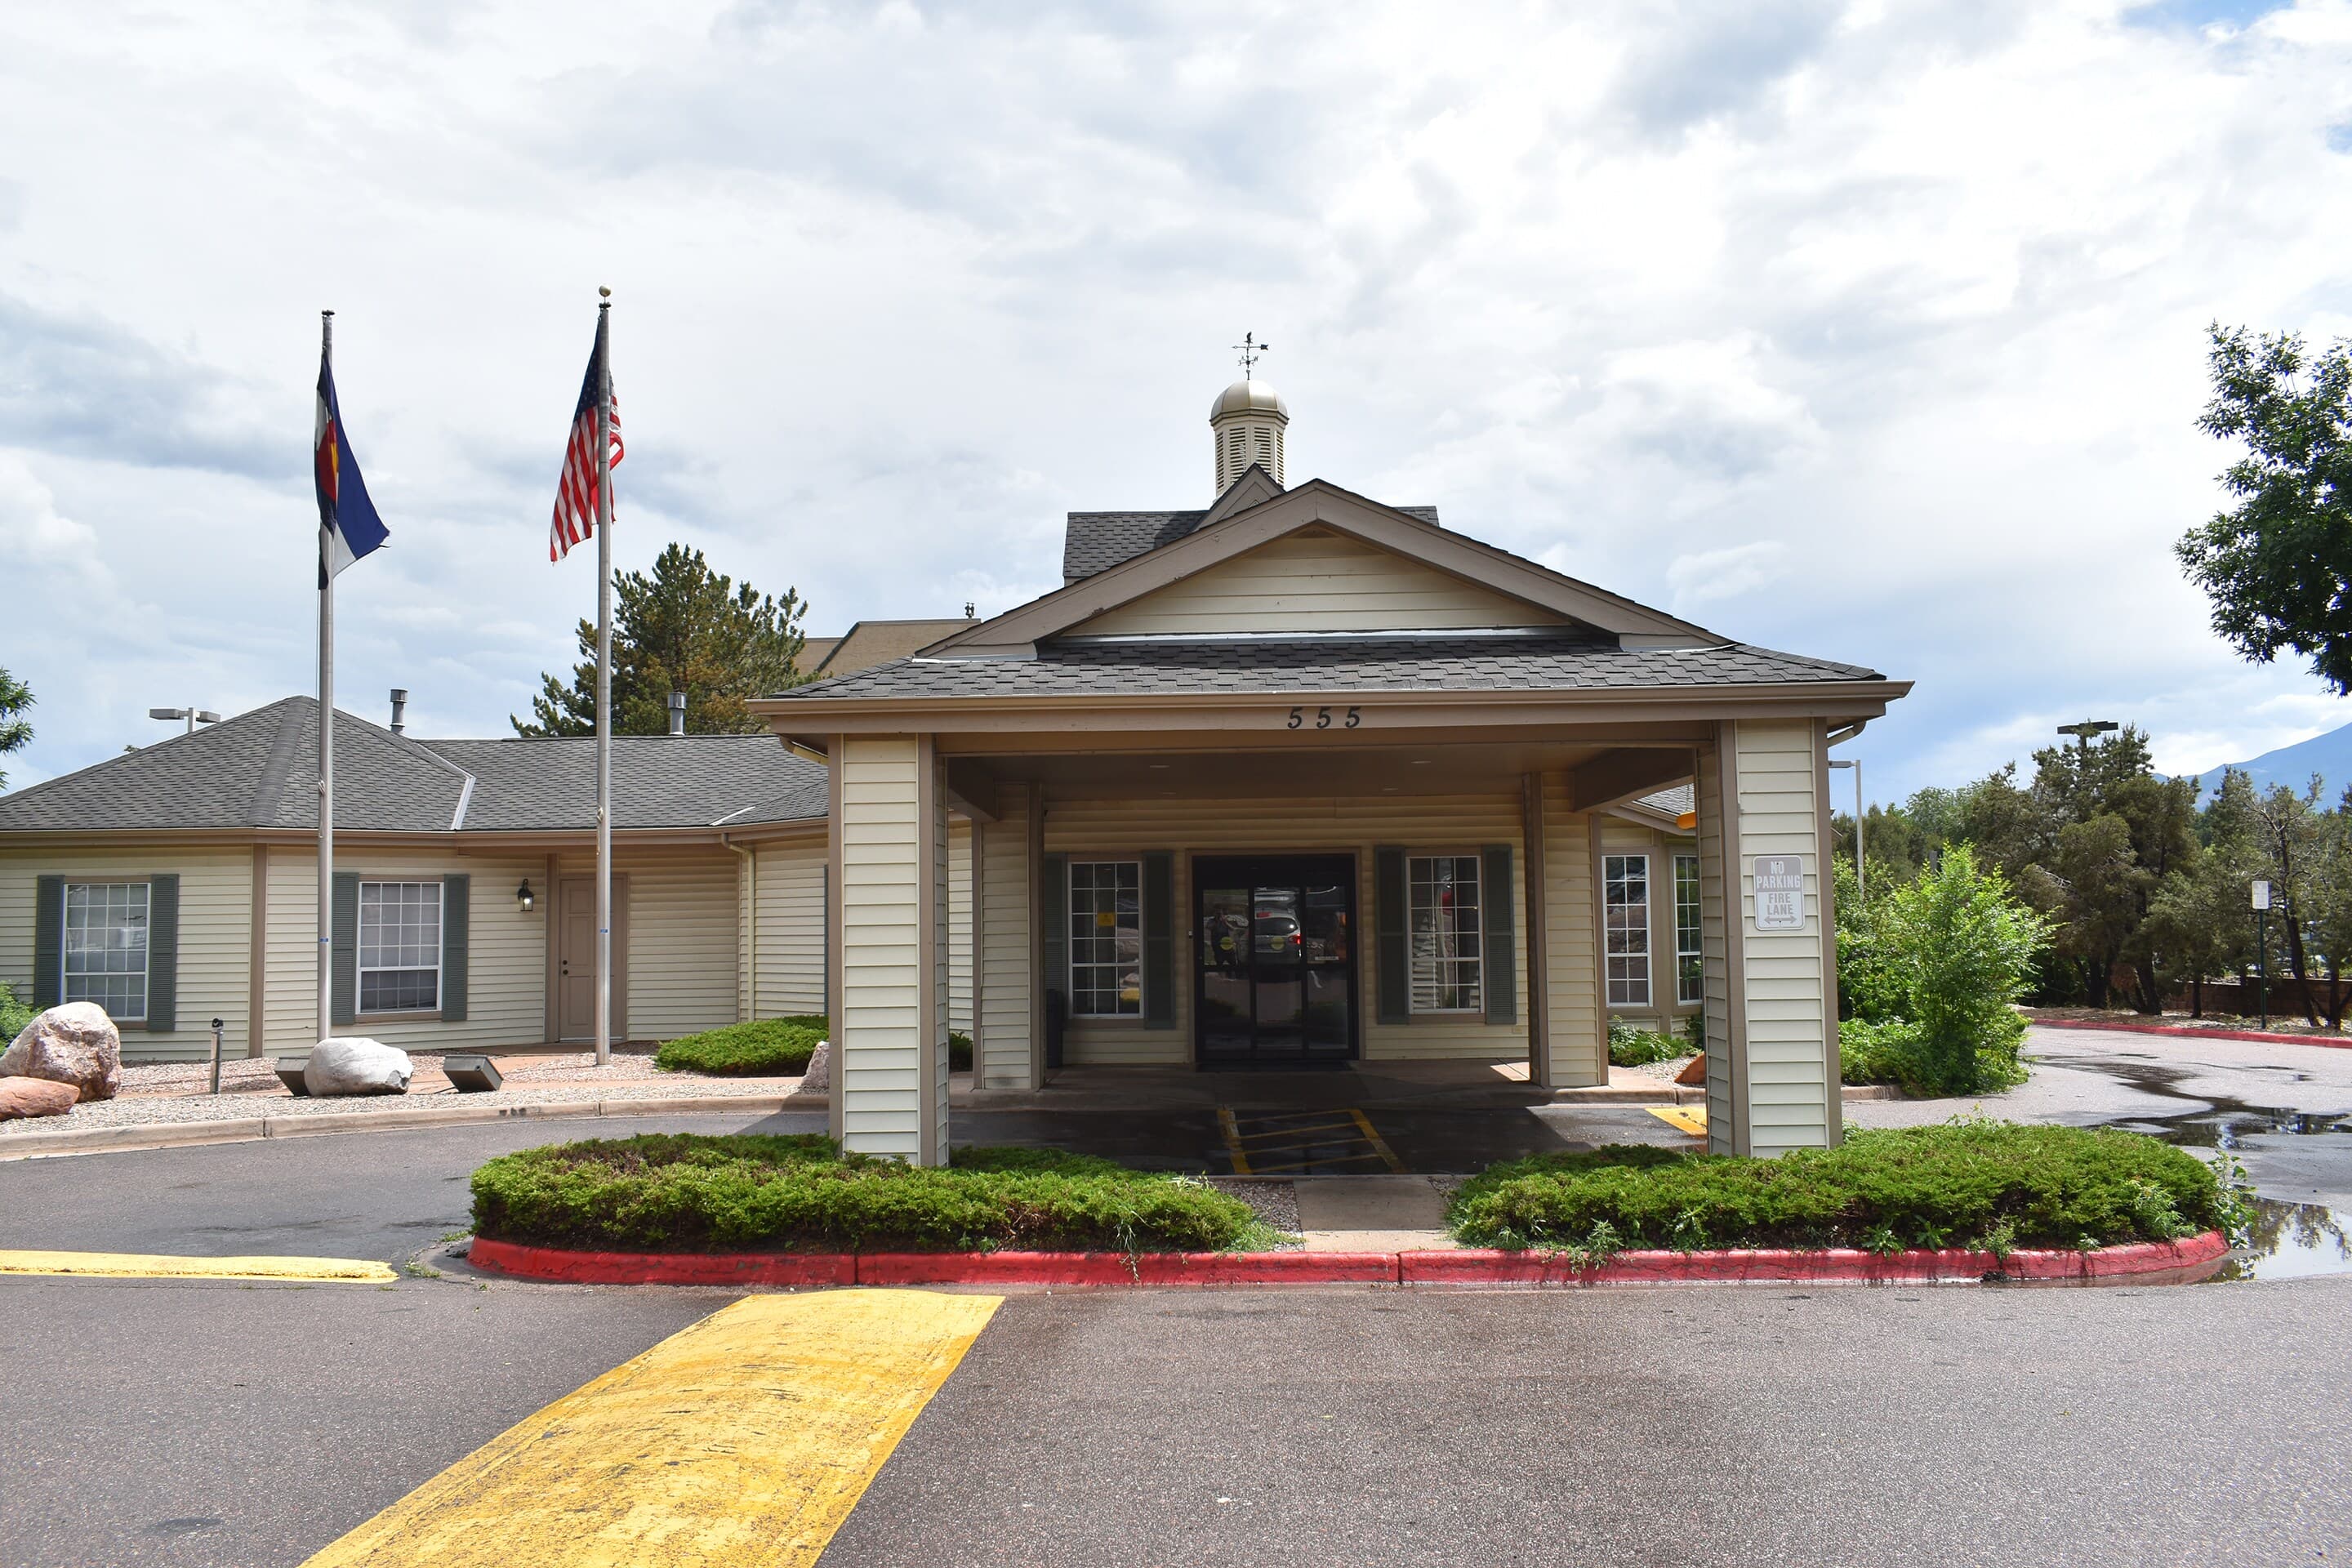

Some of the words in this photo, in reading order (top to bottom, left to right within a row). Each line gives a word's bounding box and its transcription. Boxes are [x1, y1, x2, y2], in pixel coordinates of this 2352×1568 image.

[1287, 706, 1361, 729] 555
[1770, 861, 1784, 875] NO
[1756, 875, 1801, 889] PARKING
[1768, 893, 1791, 904] FIRE
[1766, 904, 1793, 915] LANE
